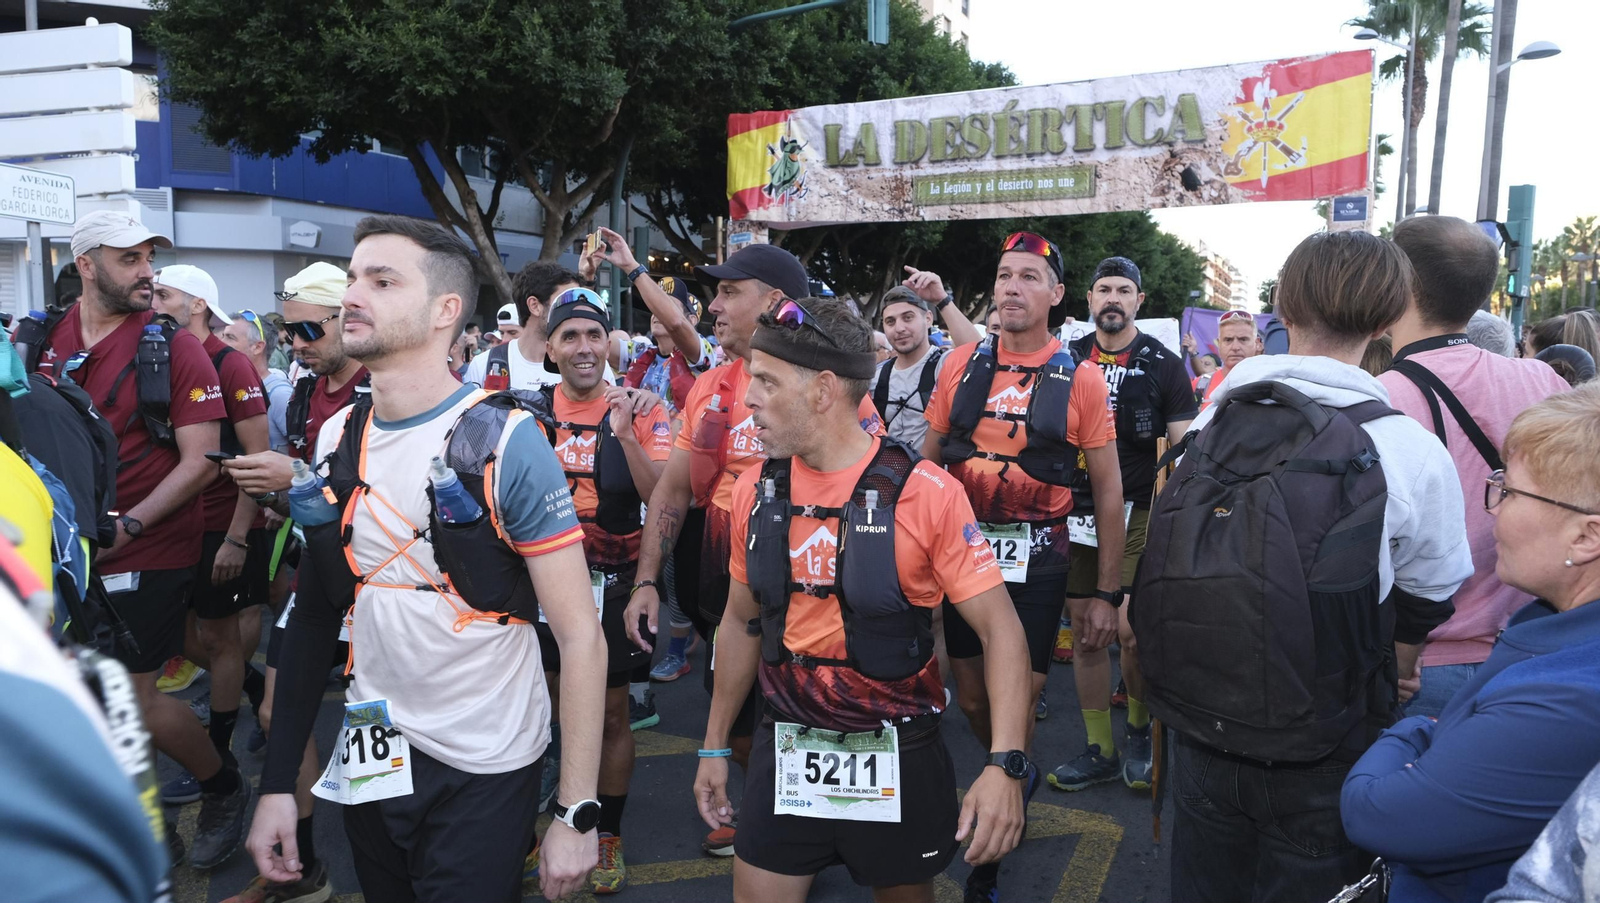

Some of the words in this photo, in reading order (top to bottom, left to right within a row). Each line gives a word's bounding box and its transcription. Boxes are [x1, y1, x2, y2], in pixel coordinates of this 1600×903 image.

[823, 122, 881, 168] LA
[893, 92, 1207, 164] DESÉRTICA
[20, 175, 70, 190] AVENIDA
[930, 182, 940, 194] La
[943, 180, 972, 196] Legión
[976, 182, 982, 194] y
[985, 179, 994, 191] el
[998, 178, 1033, 190] desierto
[1037, 179, 1053, 189] nos
[1058, 177, 1075, 188] une
[12, 186, 59, 204] FEDERICO
[1, 198, 37, 215] GARCÍA
[40, 203, 70, 220] LORCA
[1447, 338, 1469, 346] SONY
[1050, 372, 1071, 382] KIPRUN
[733, 432, 747, 450] la
[563, 446, 576, 464] la
[920, 469, 945, 489] Sacrificio
[545, 493, 554, 502] LA
[546, 504, 556, 513] EL
[556, 507, 573, 520] NOS
[855, 524, 887, 534] KIPRUN
[984, 538, 1018, 561] 12
[807, 548, 821, 576] la
[342, 725, 390, 765] 318
[805, 752, 877, 787] 5211
